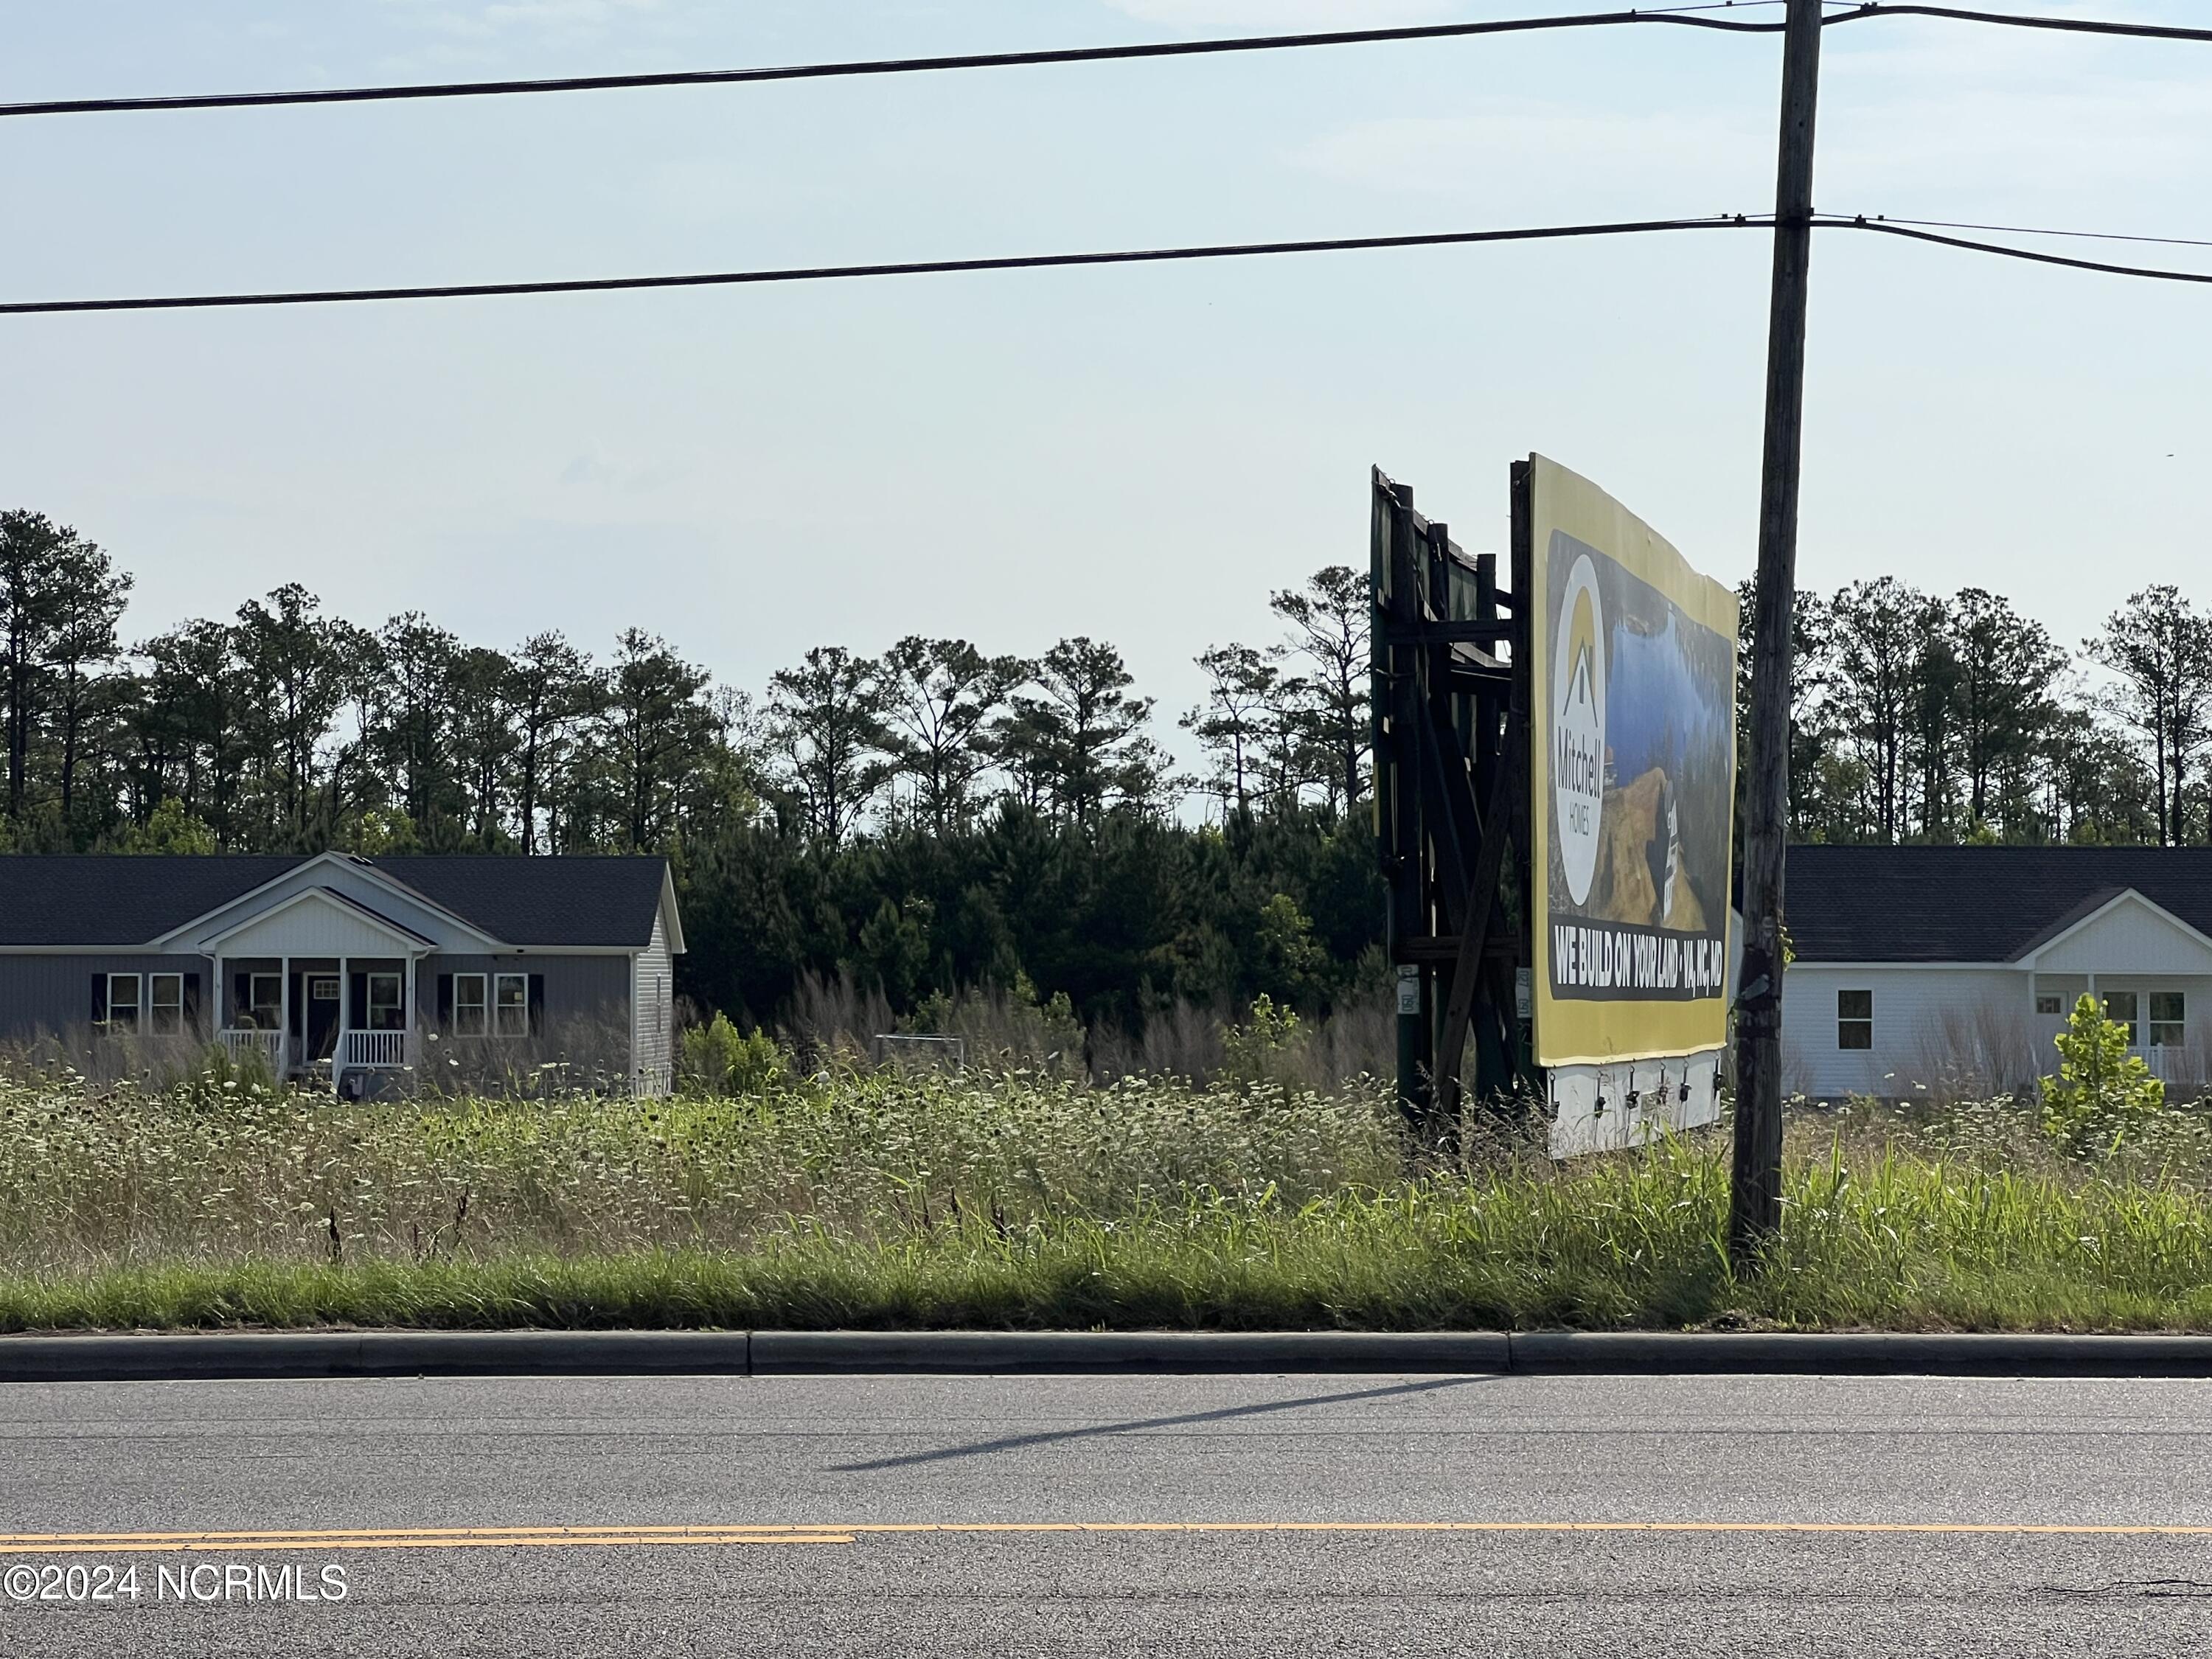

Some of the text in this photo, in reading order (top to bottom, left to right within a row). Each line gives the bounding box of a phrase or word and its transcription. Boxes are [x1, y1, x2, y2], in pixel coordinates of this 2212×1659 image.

[1558, 726, 1601, 799] Mitchell
[1569, 801, 1589, 836] HOMES
[1554, 925, 1723, 998] WE BUILD ON YOUR LAND VA, NC, MD
